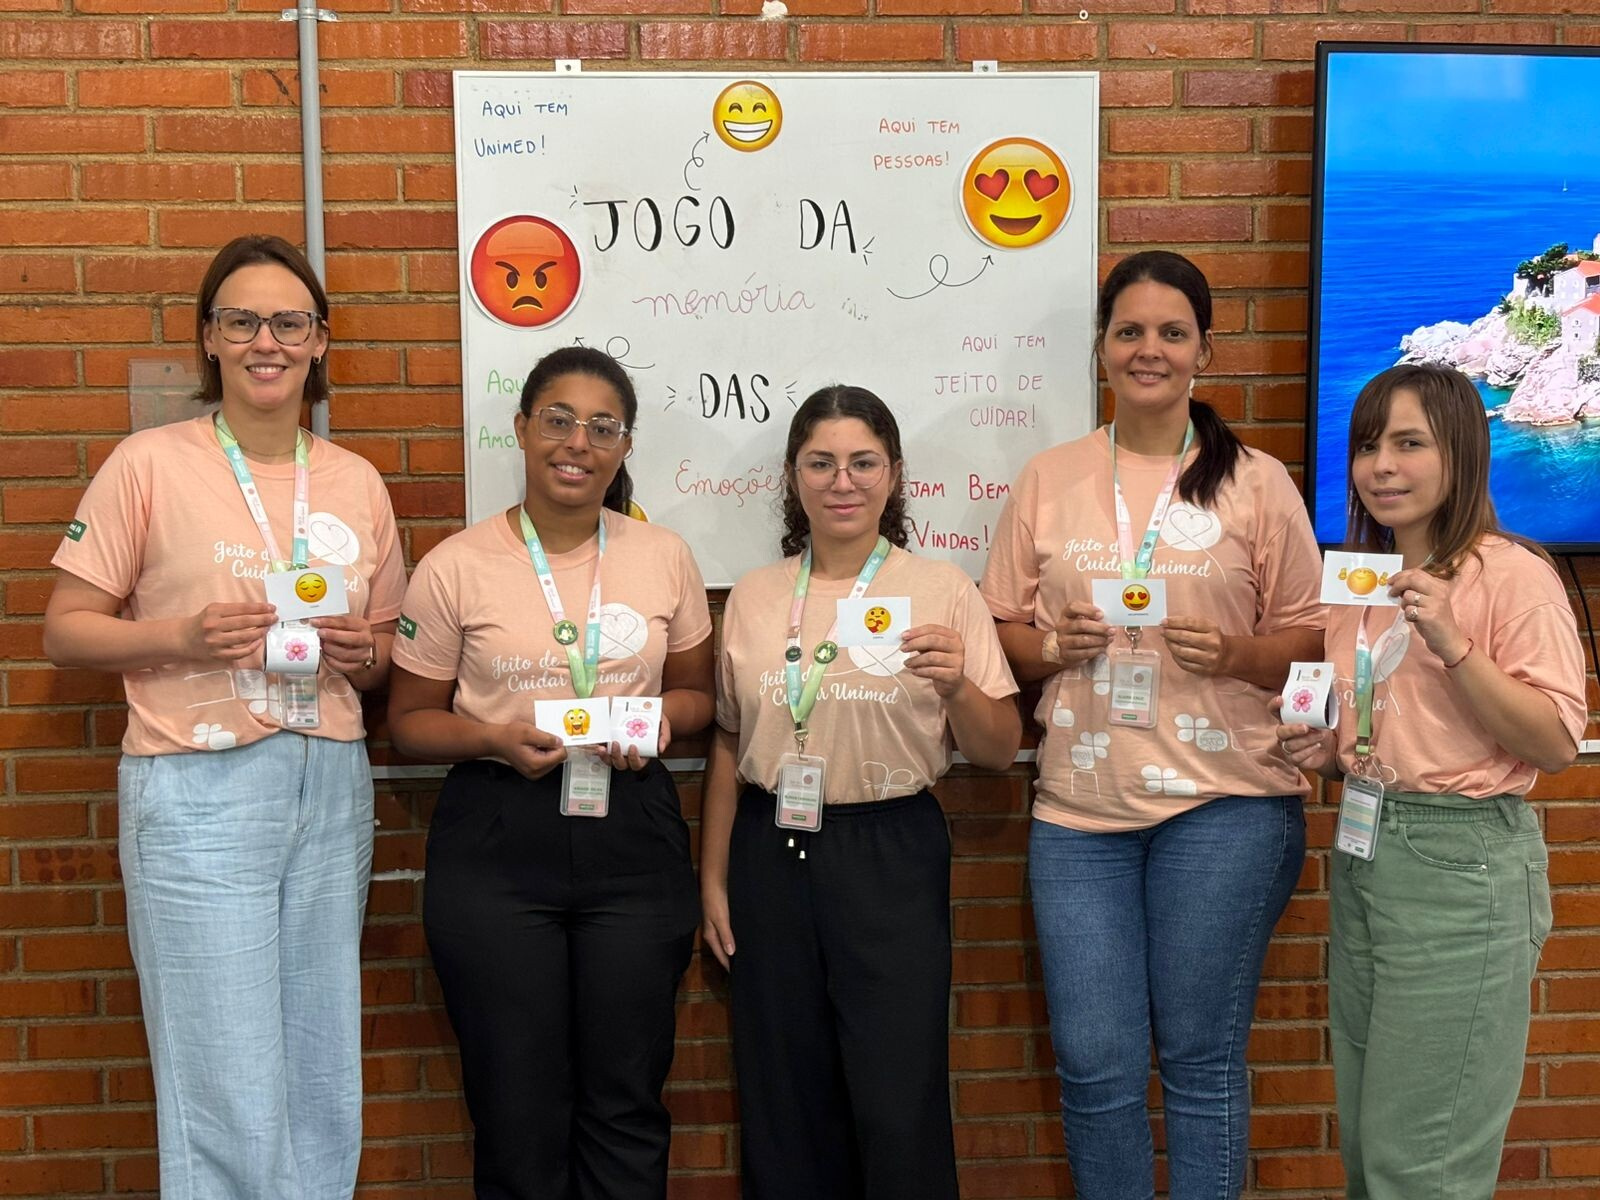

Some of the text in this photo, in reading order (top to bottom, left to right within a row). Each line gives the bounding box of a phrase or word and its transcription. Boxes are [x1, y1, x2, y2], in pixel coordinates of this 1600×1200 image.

[534, 101, 568, 116] TEM
[927, 120, 960, 134] TEM
[873, 154, 949, 170] PESSOAS!
[583, 195, 856, 253] JOGO DA
[632, 272, 816, 317] memória
[1014, 335, 1045, 348] TEM
[487, 369, 526, 395] AQU
[1018, 375, 1043, 391] DE
[700, 373, 770, 423] DAS
[479, 425, 516, 449] AMO
[214, 540, 270, 563] Jeito d
[1062, 538, 1119, 561] Jeito d
[231, 559, 271, 580] Cuid
[491, 648, 560, 680] Jeito de
[507, 671, 568, 693] Cuidar
[759, 664, 812, 696] Jeit d
[830, 682, 899, 705] Unimed
